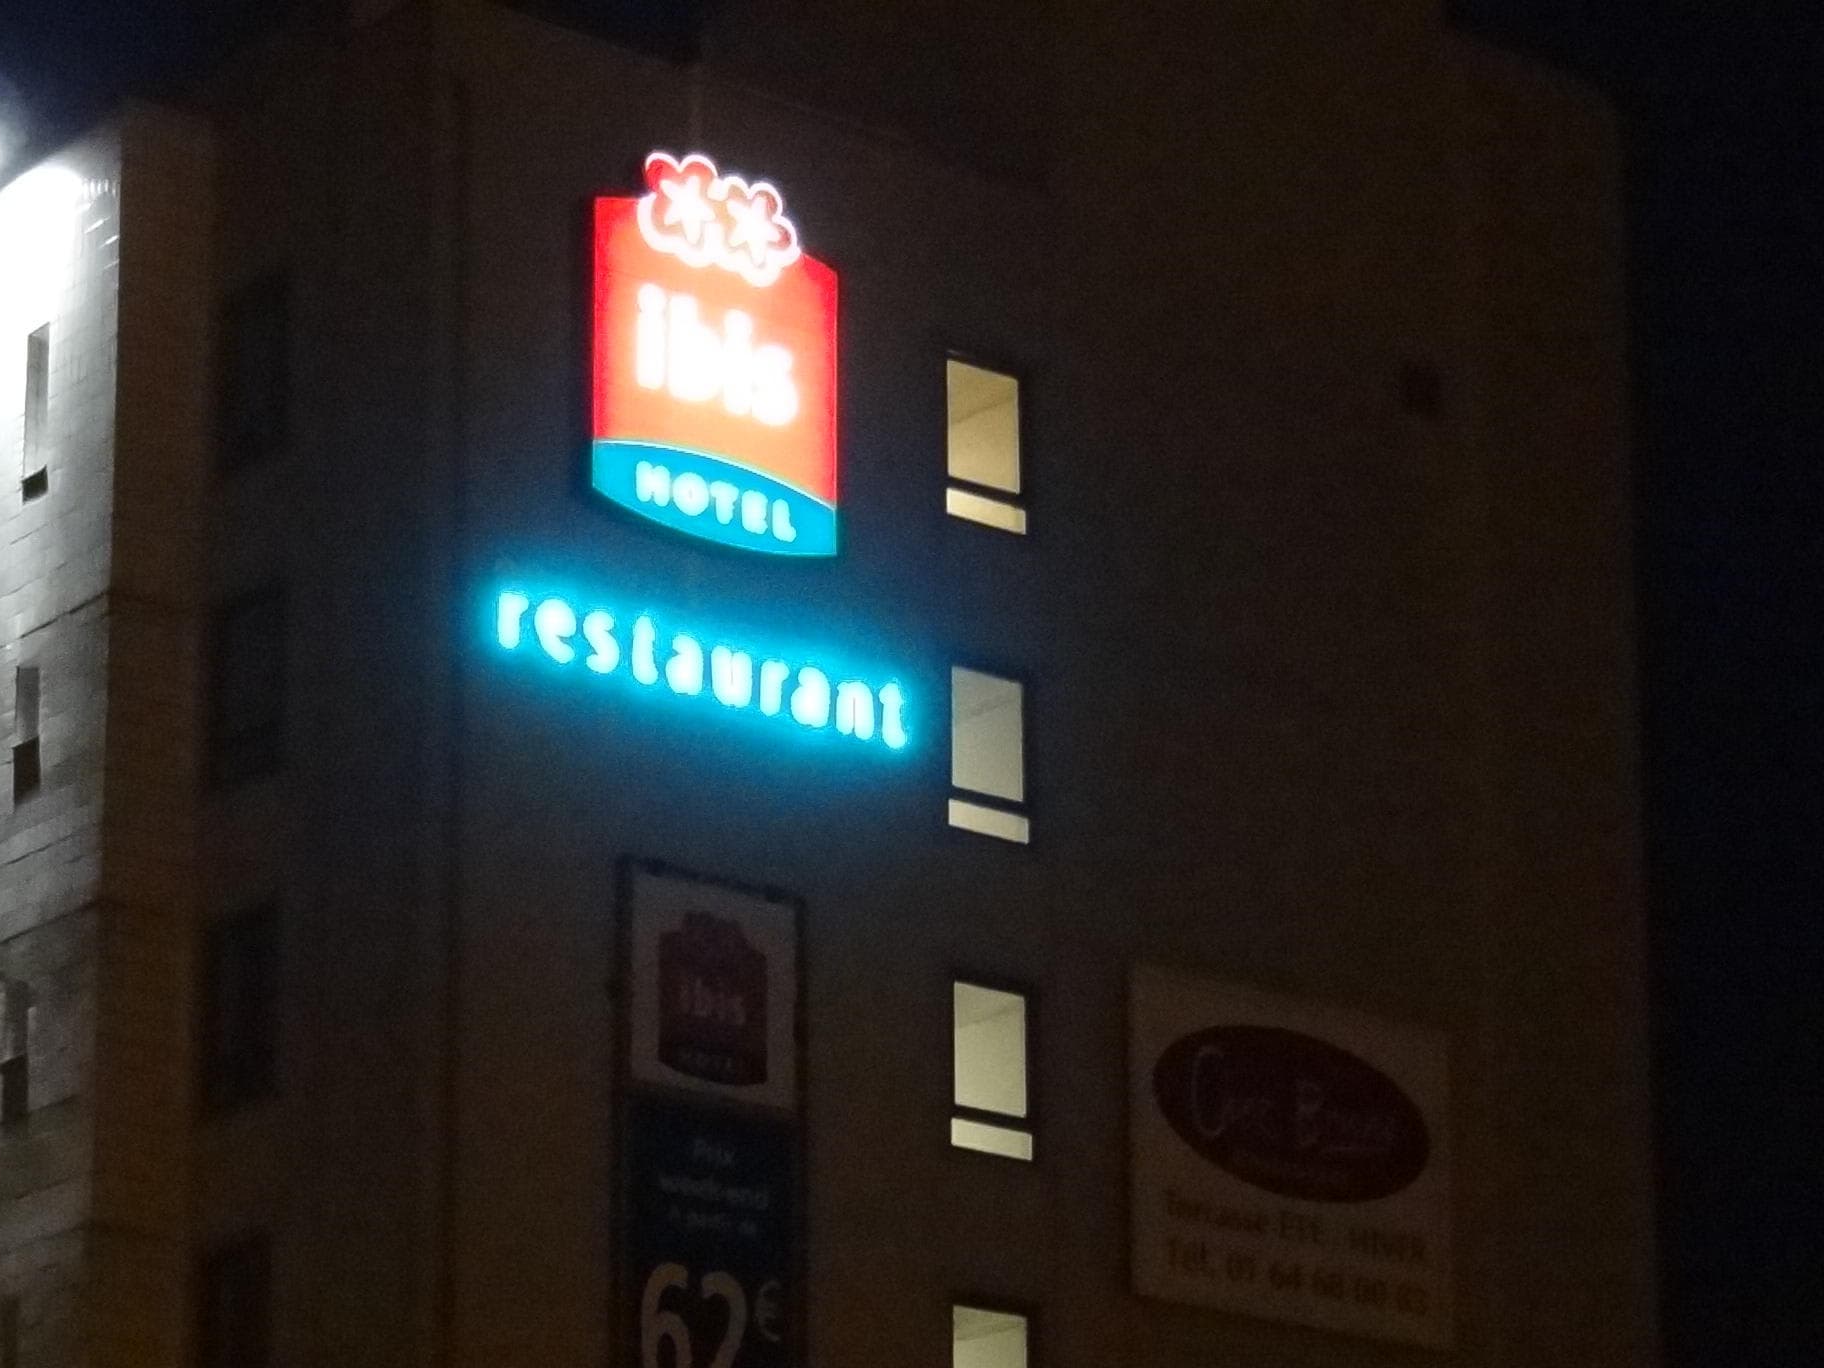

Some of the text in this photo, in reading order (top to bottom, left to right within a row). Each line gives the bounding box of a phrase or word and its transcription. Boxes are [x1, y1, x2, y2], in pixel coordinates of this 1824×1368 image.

[634, 284, 800, 425] ibis
[635, 459, 797, 543] HOTEL
[496, 591, 908, 750] restaurant
